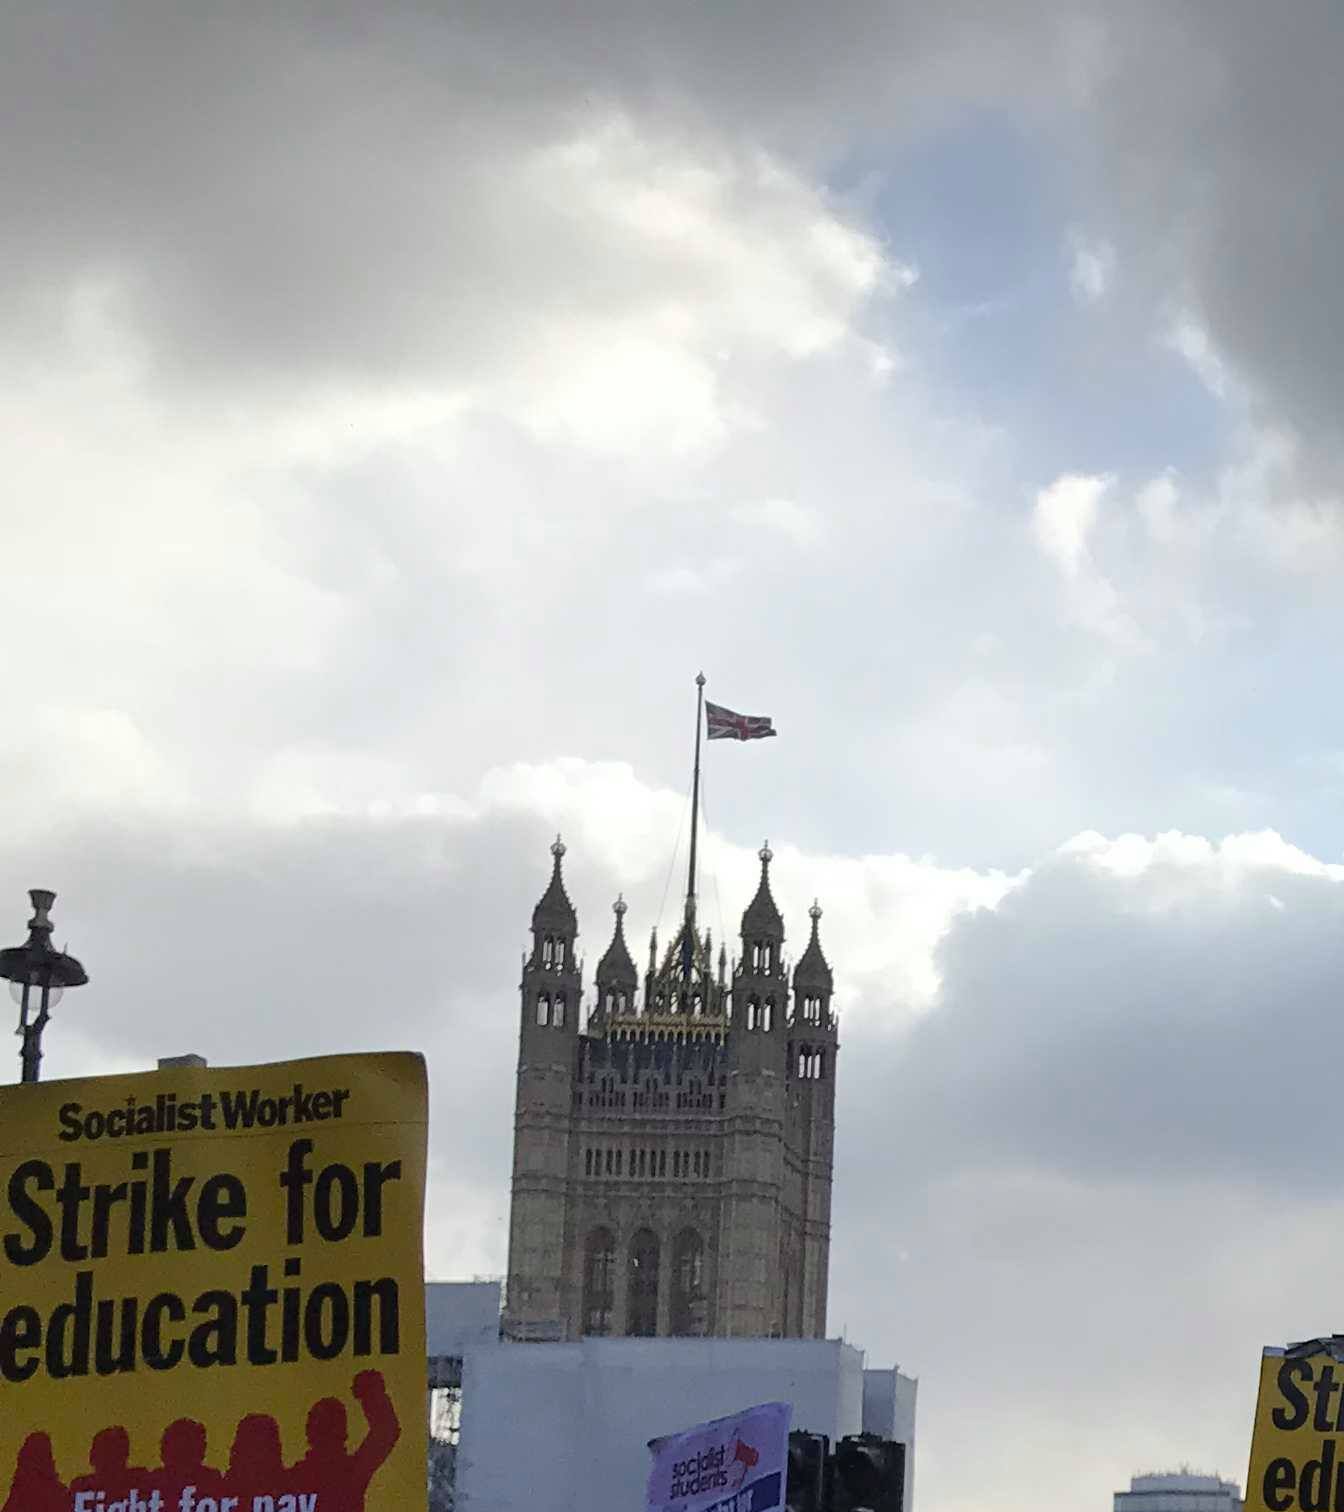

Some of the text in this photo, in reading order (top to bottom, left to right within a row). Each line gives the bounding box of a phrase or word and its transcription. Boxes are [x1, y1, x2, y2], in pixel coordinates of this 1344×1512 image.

[57, 1085, 350, 1142] Socialist Worker
[3, 1140, 400, 1267] Strike for
[0, 1258, 400, 1382] education
[672, 1445, 725, 1479] socialist
